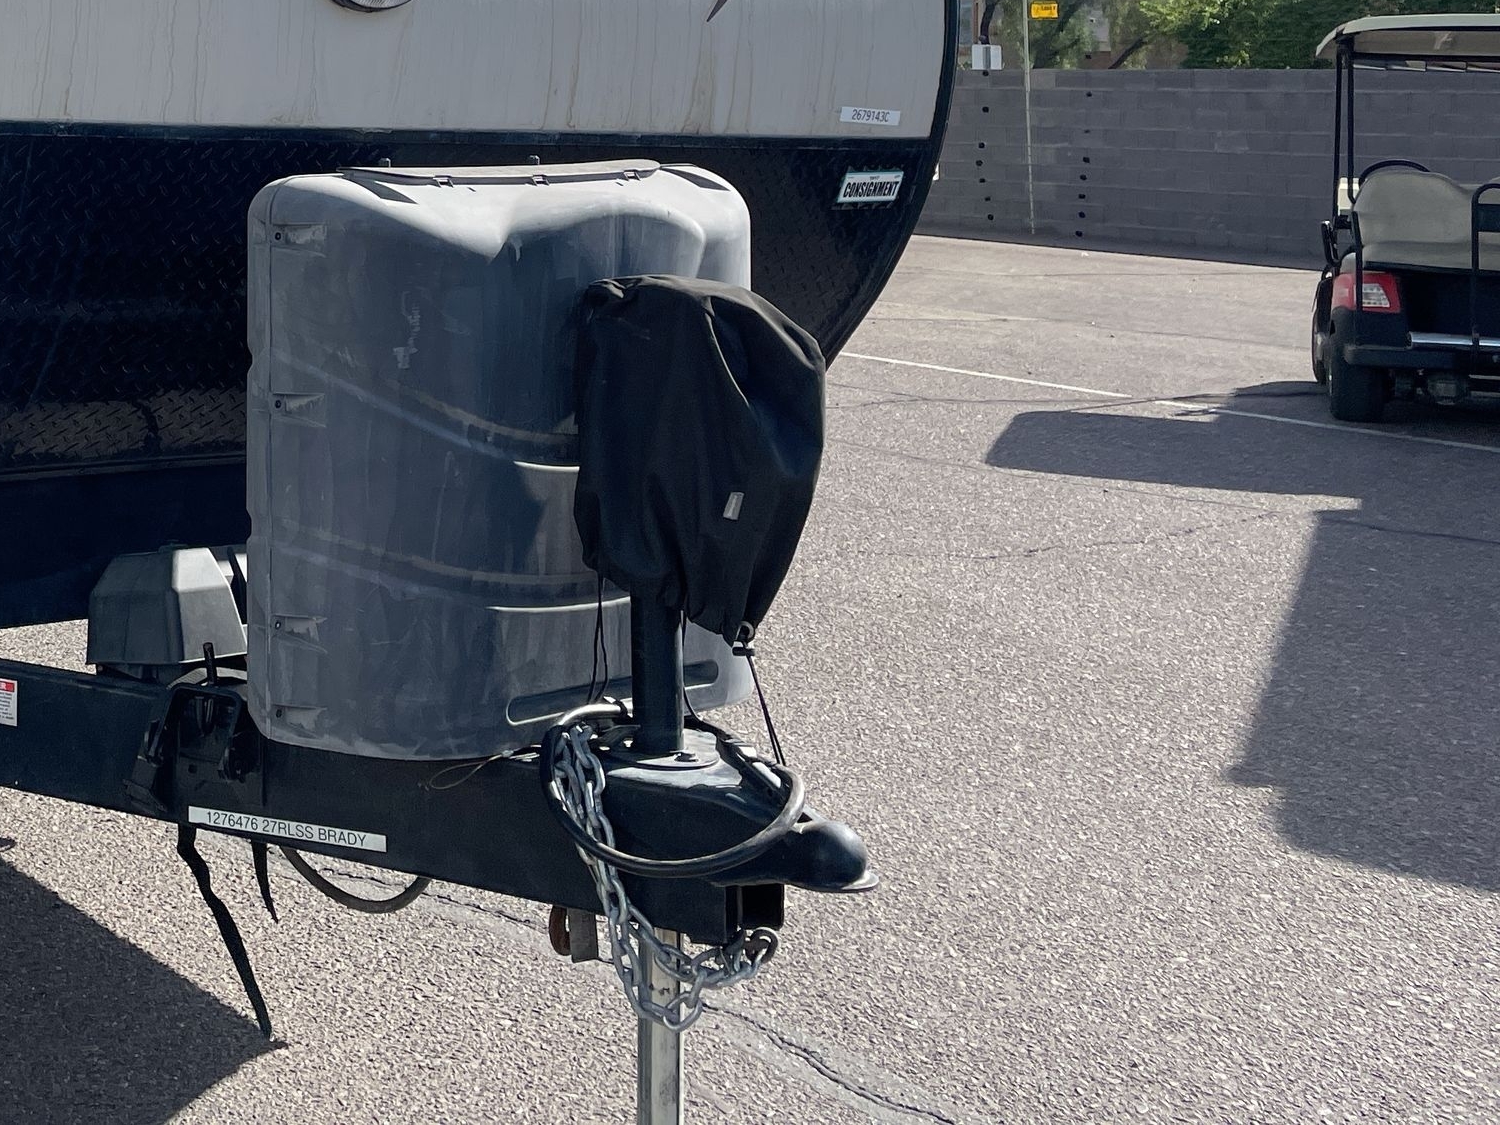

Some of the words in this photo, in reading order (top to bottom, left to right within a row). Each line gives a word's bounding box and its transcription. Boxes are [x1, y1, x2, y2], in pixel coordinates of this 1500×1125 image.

[851, 108, 890, 123] 2679143C
[843, 180, 900, 198] CONSIGNMENT
[206, 811, 259, 831] 1276476
[262, 820, 314, 839] 27RLSS
[318, 828, 367, 847] BRADY
